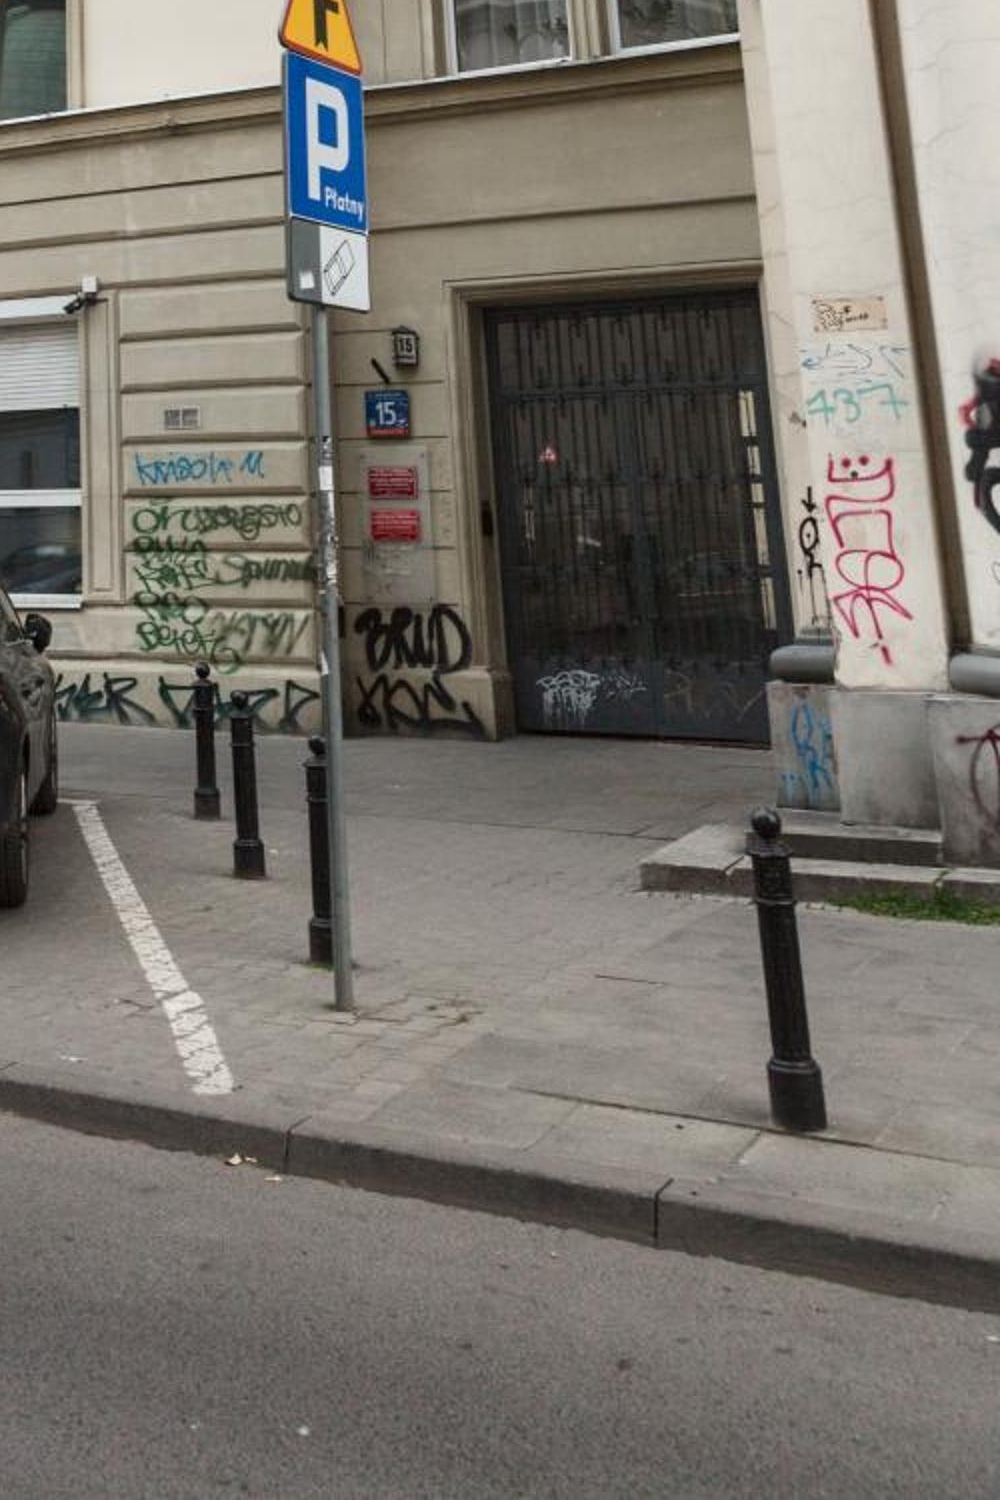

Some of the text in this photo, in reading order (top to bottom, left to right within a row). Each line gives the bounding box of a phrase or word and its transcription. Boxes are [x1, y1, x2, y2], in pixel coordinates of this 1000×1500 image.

[305, 77, 350, 202] P
[325, 186, 364, 222] Płatny
[398, 337, 413, 354] 15
[375, 400, 397, 426] 15
